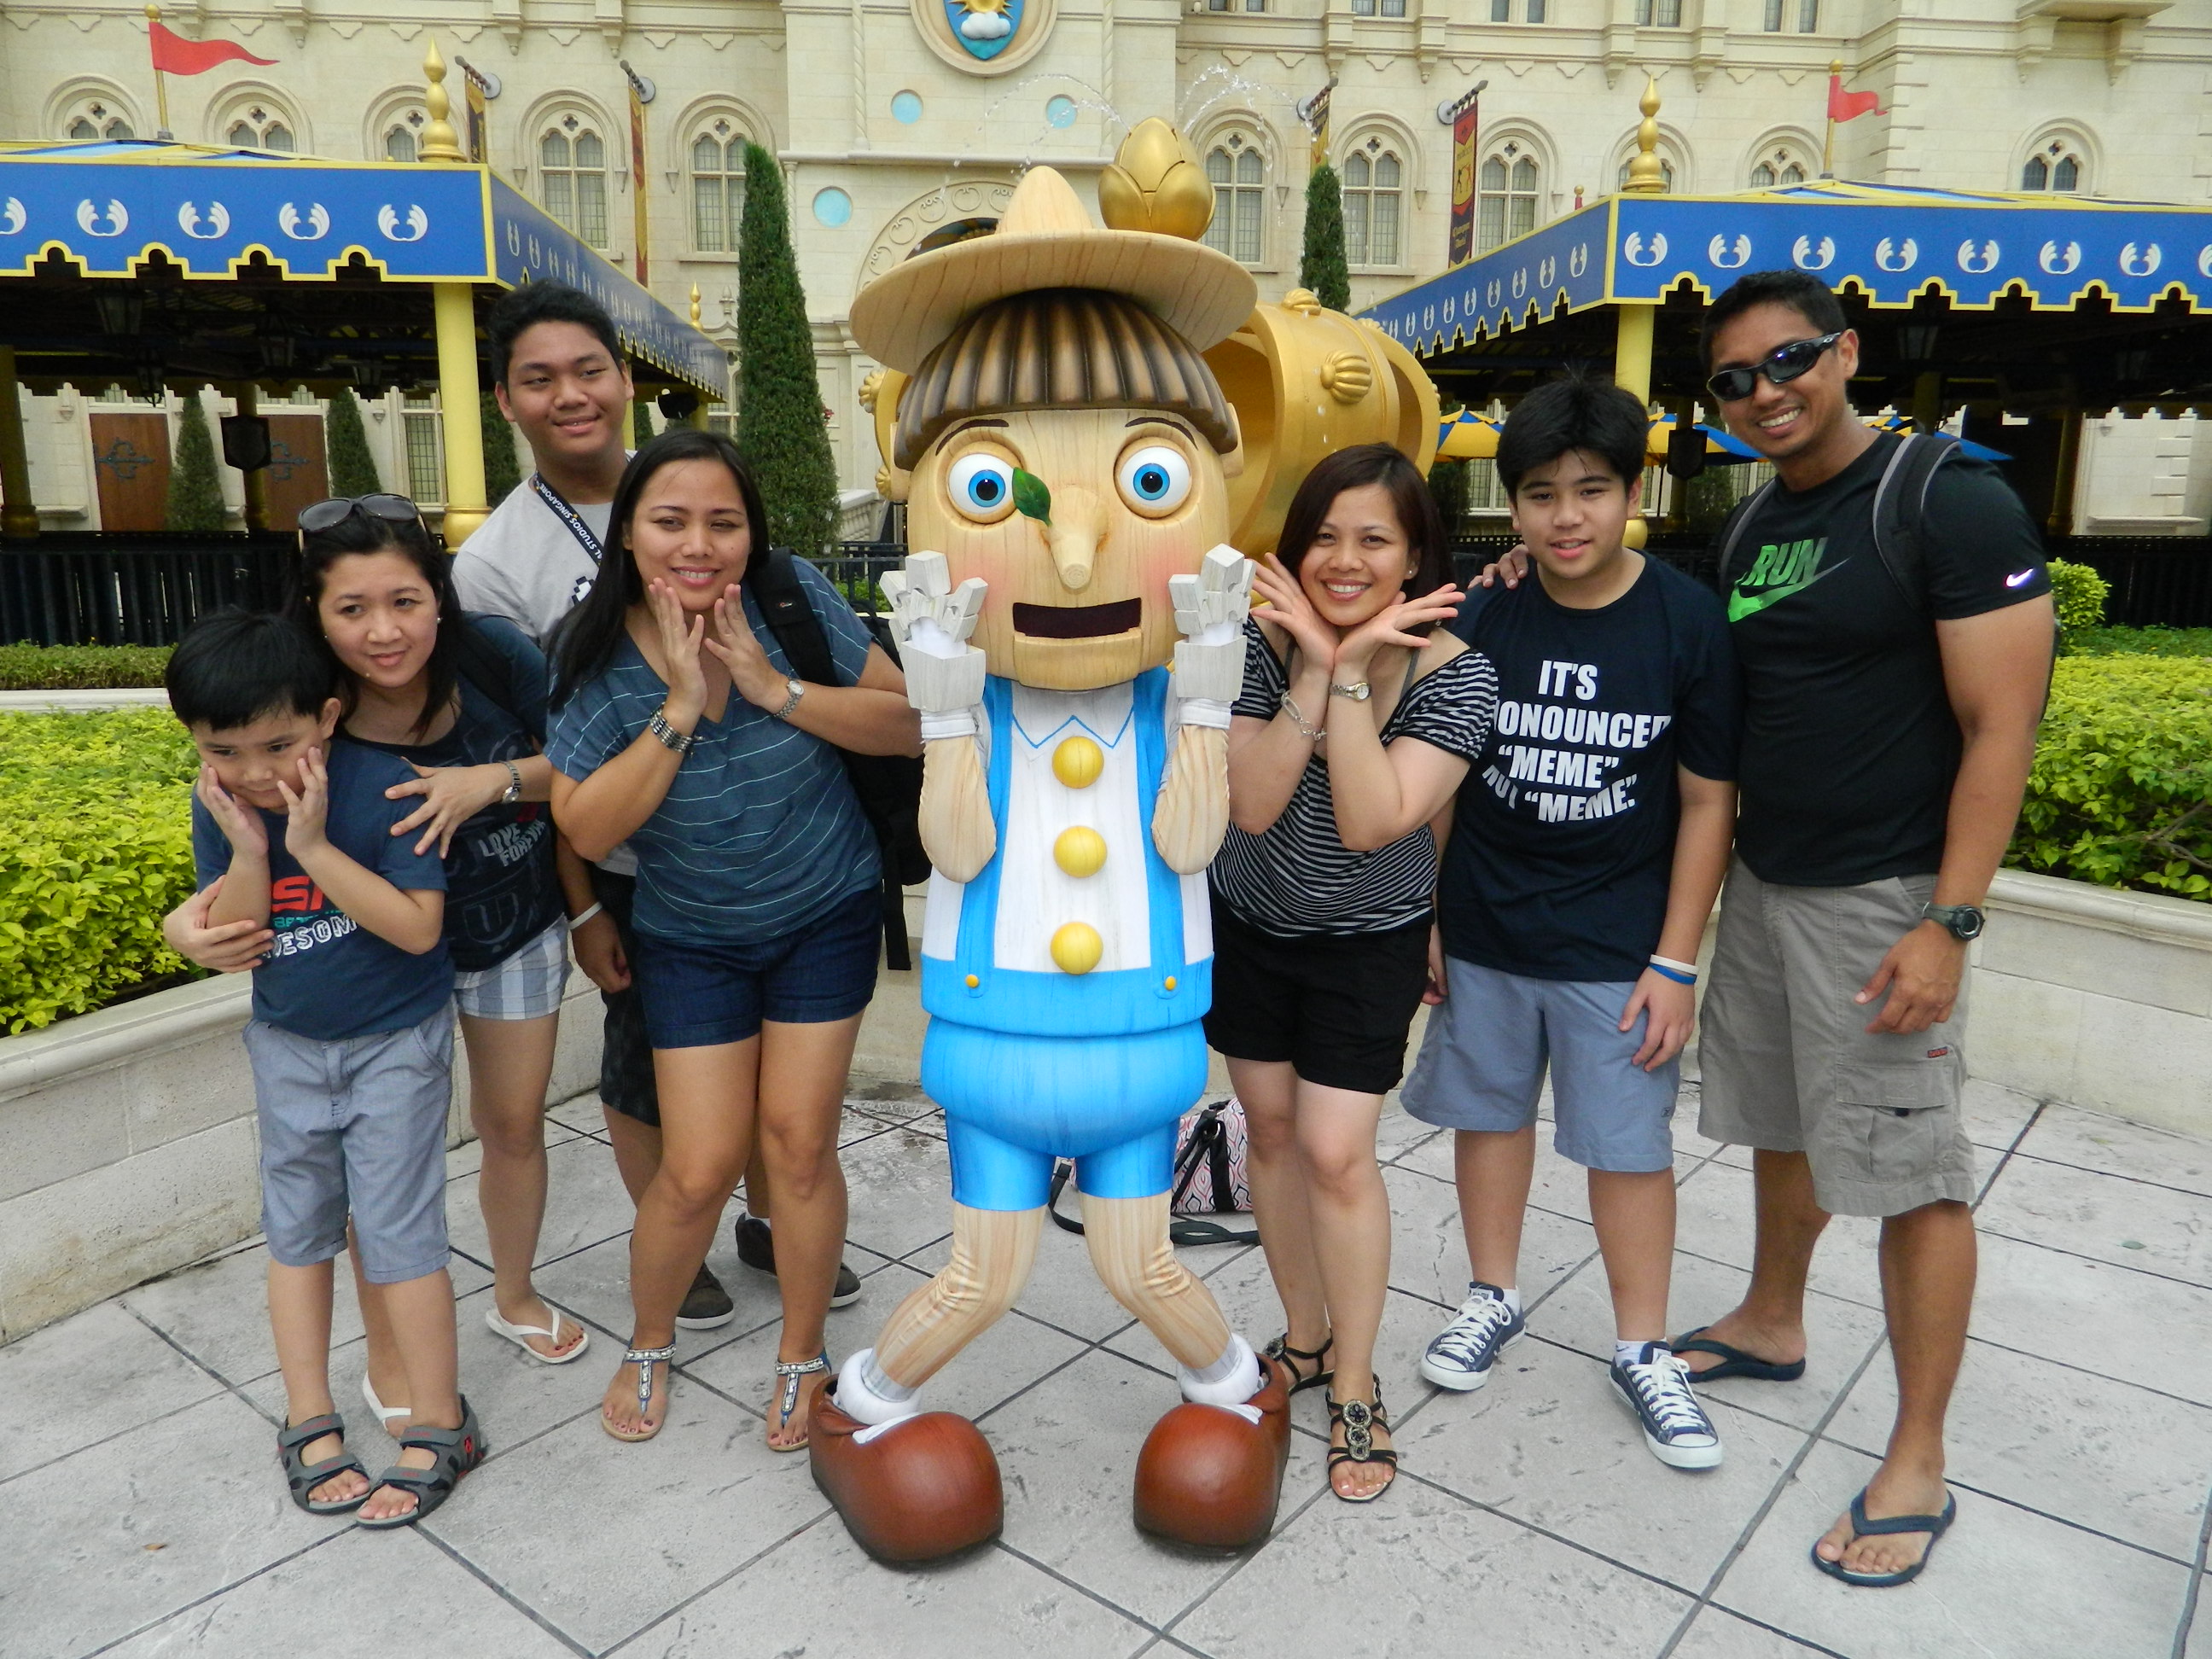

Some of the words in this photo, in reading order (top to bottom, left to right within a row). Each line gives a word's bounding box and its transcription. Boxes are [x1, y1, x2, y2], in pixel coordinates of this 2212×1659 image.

[539, 482, 573, 519] SINGAPORE
[569, 516, 597, 550] STUDIOS
[1743, 537, 1829, 586] RUN
[1538, 660, 1598, 701] IT'S
[1494, 699, 1672, 748] ONOUNCED
[478, 822, 521, 858] LOVE
